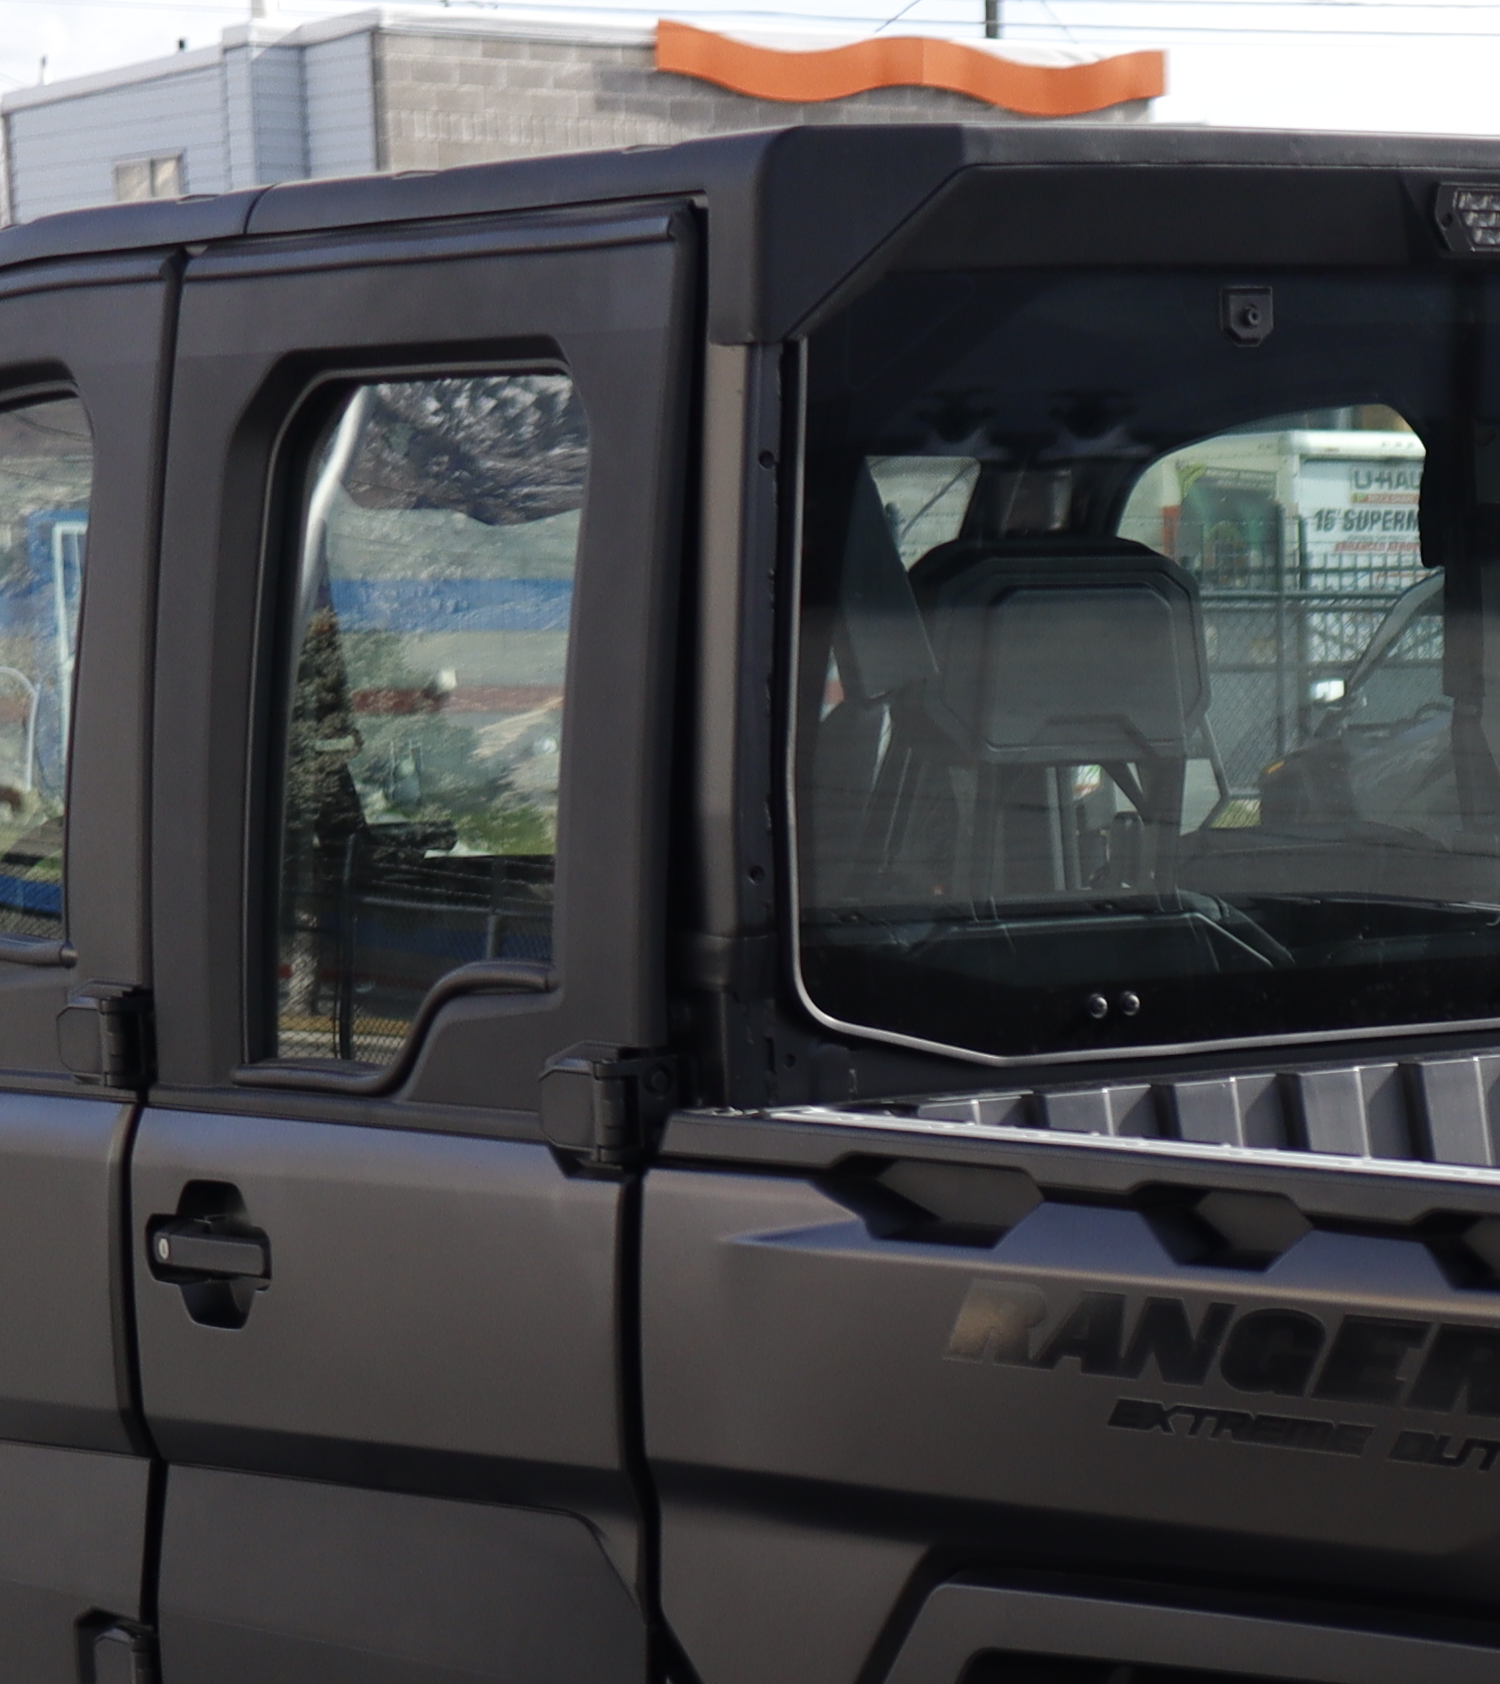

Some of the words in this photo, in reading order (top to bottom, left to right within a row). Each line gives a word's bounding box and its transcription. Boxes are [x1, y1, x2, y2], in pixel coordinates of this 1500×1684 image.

[1353, 470, 1421, 490] U-HAU
[1342, 508, 1421, 533] SUPERM
[1107, 1397, 1376, 1458] EXTREME
